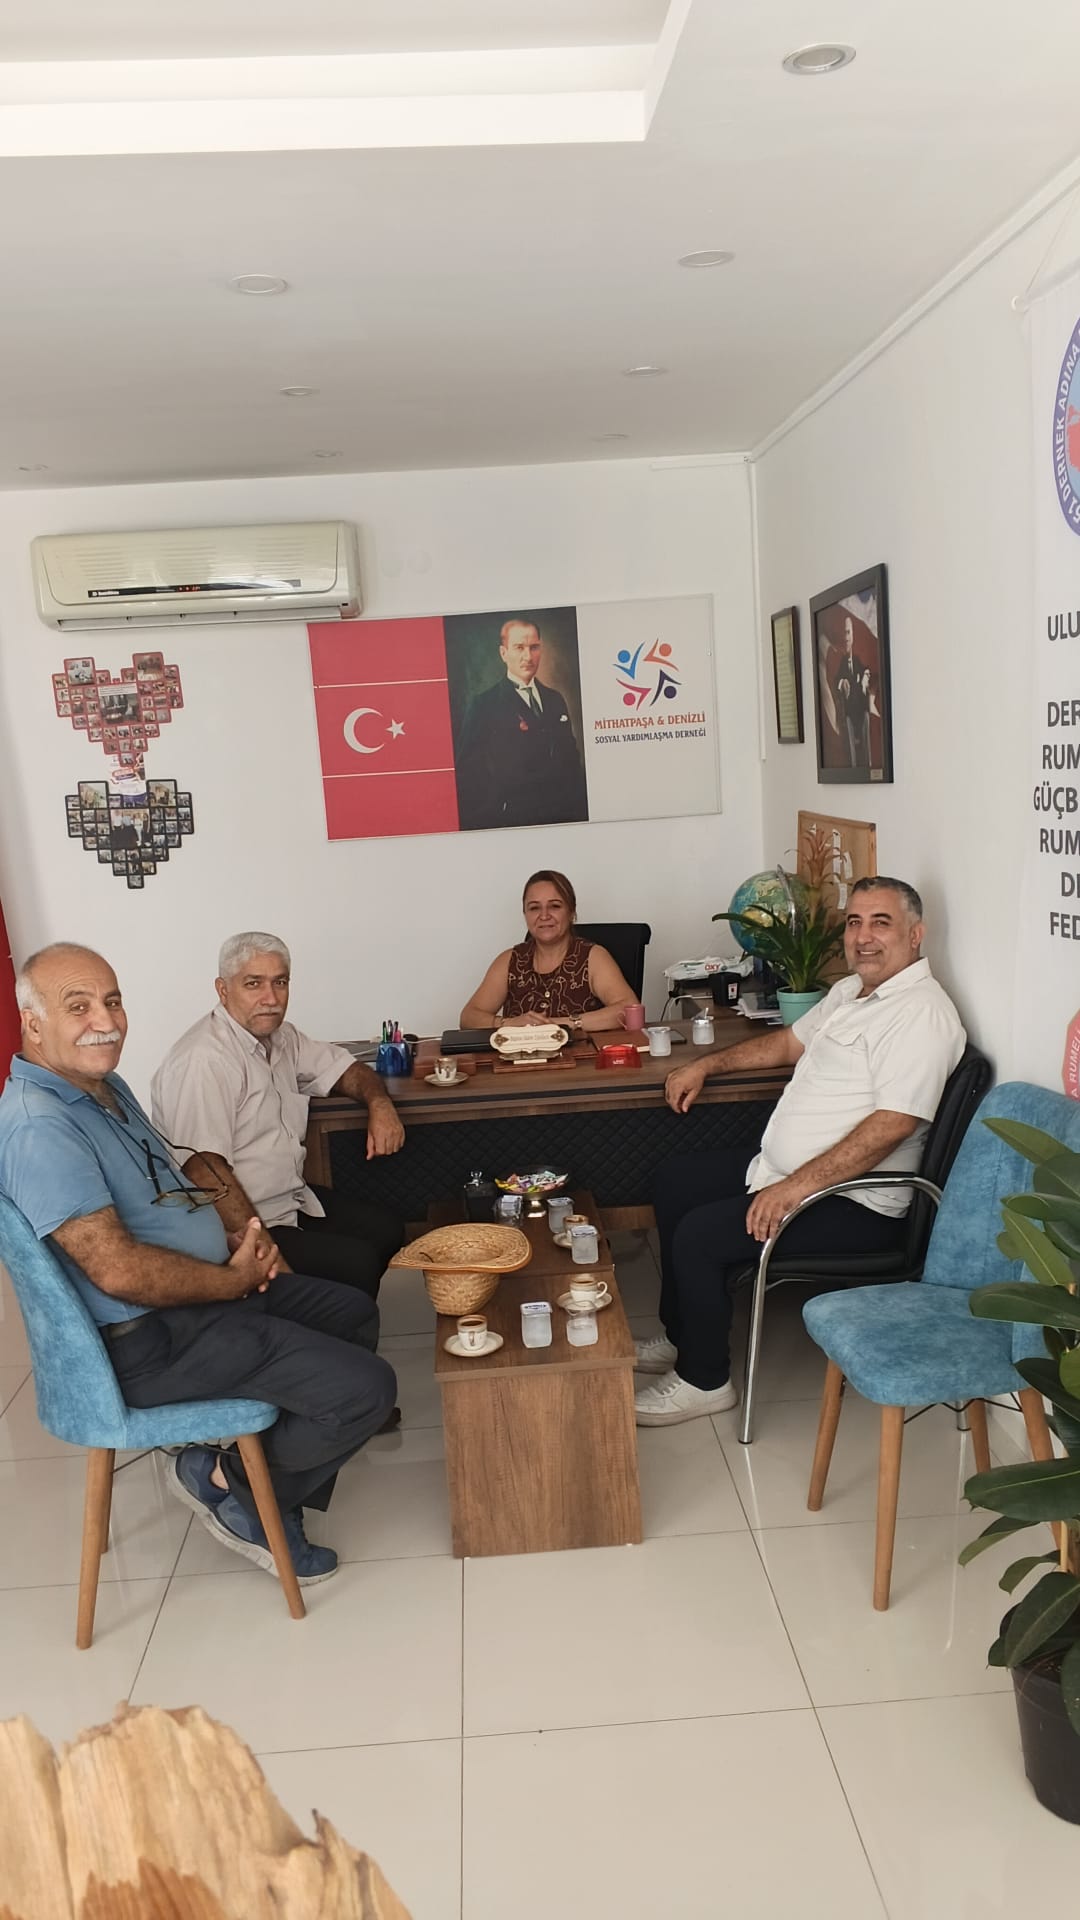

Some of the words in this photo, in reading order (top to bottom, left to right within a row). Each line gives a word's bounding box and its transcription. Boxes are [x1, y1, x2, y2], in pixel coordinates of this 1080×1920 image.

[1056, 416, 1071, 502] DERNEK
[594, 717, 655, 730] MİTHATPAŞA
[657, 715, 665, 726] &
[667, 711, 706, 725] DENİZLİ
[595, 735, 621, 744] SOSYAL
[622, 731, 673, 741] YARDIMLAŞMA
[675, 728, 706, 739] DERNEĞİ
[1033, 780, 1079, 820] GÜÇB
